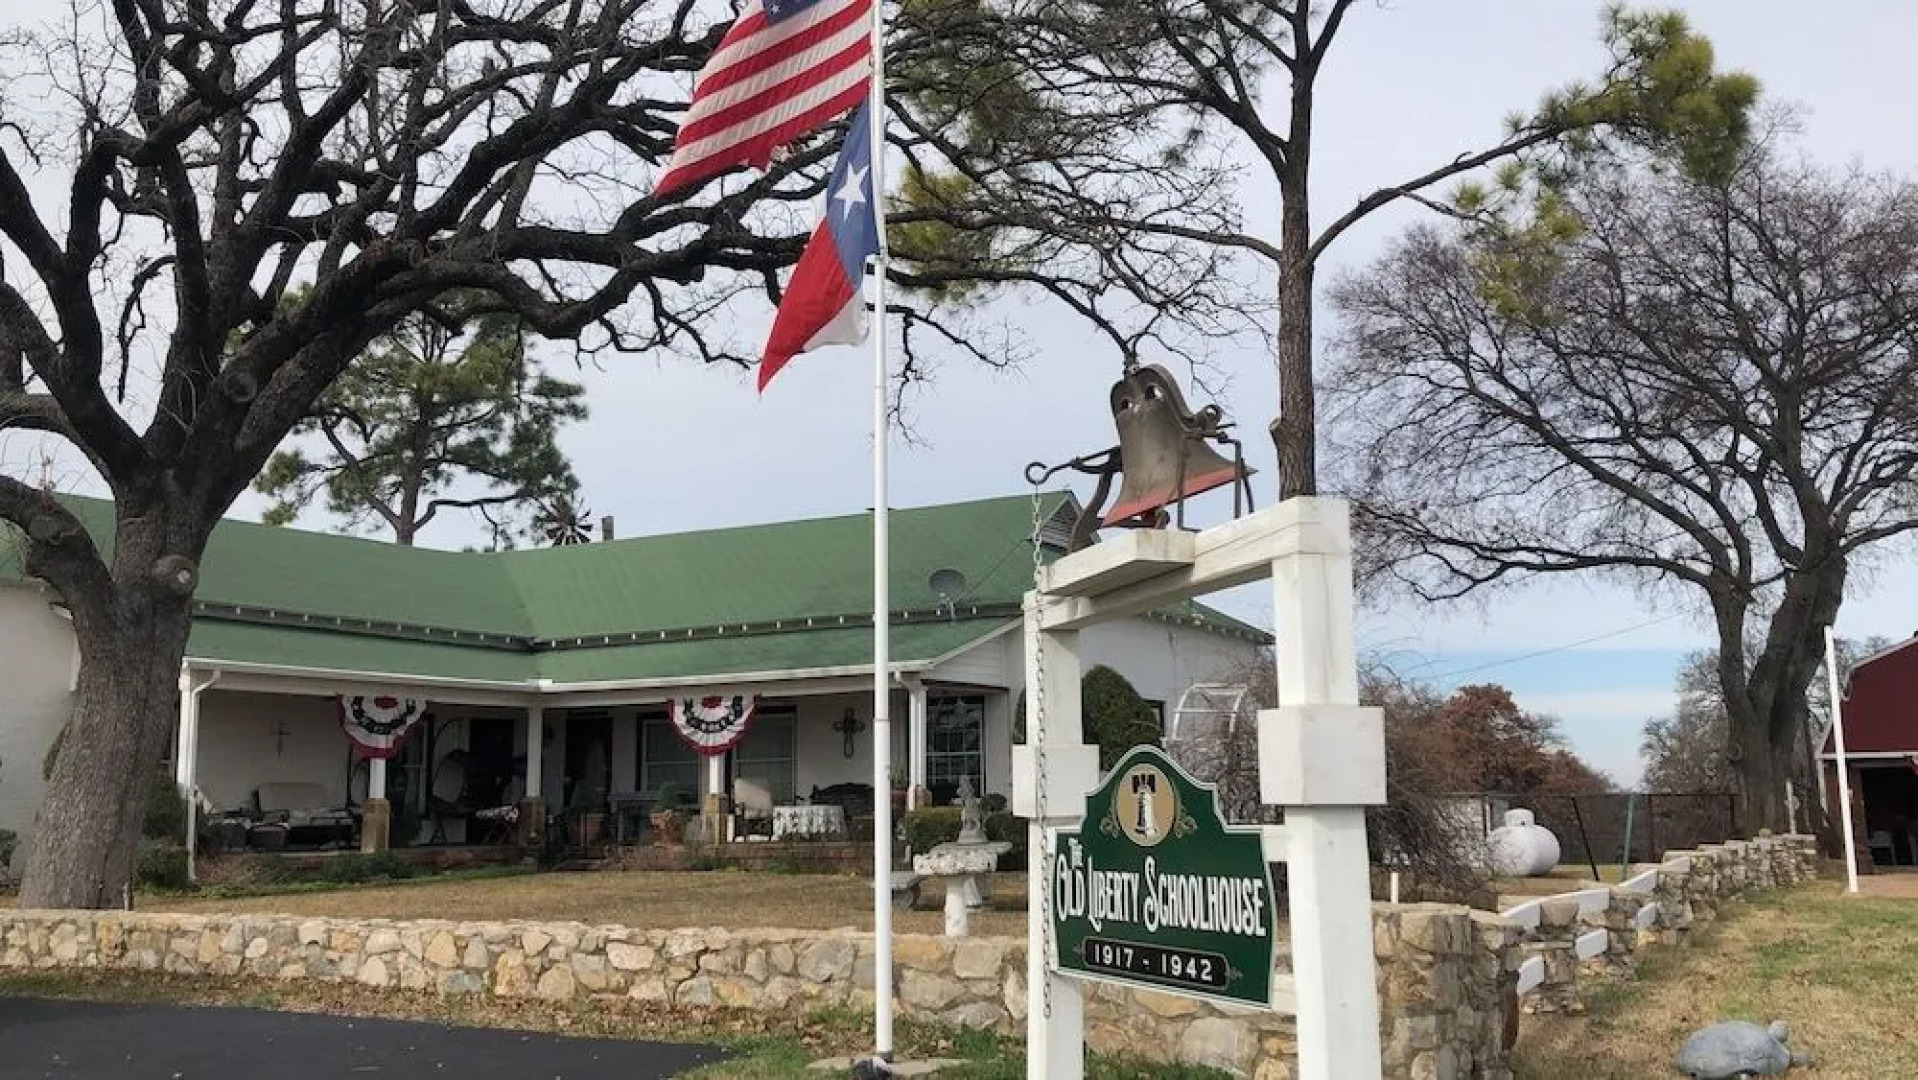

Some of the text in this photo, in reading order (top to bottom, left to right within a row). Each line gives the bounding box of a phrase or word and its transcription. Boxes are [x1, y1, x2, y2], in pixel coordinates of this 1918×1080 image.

[1056, 853, 1267, 937] OLD LIBERTY SCHOOLHOUSE
[1094, 943, 1134, 969] 1917
[1161, 953, 1213, 982] 1942
